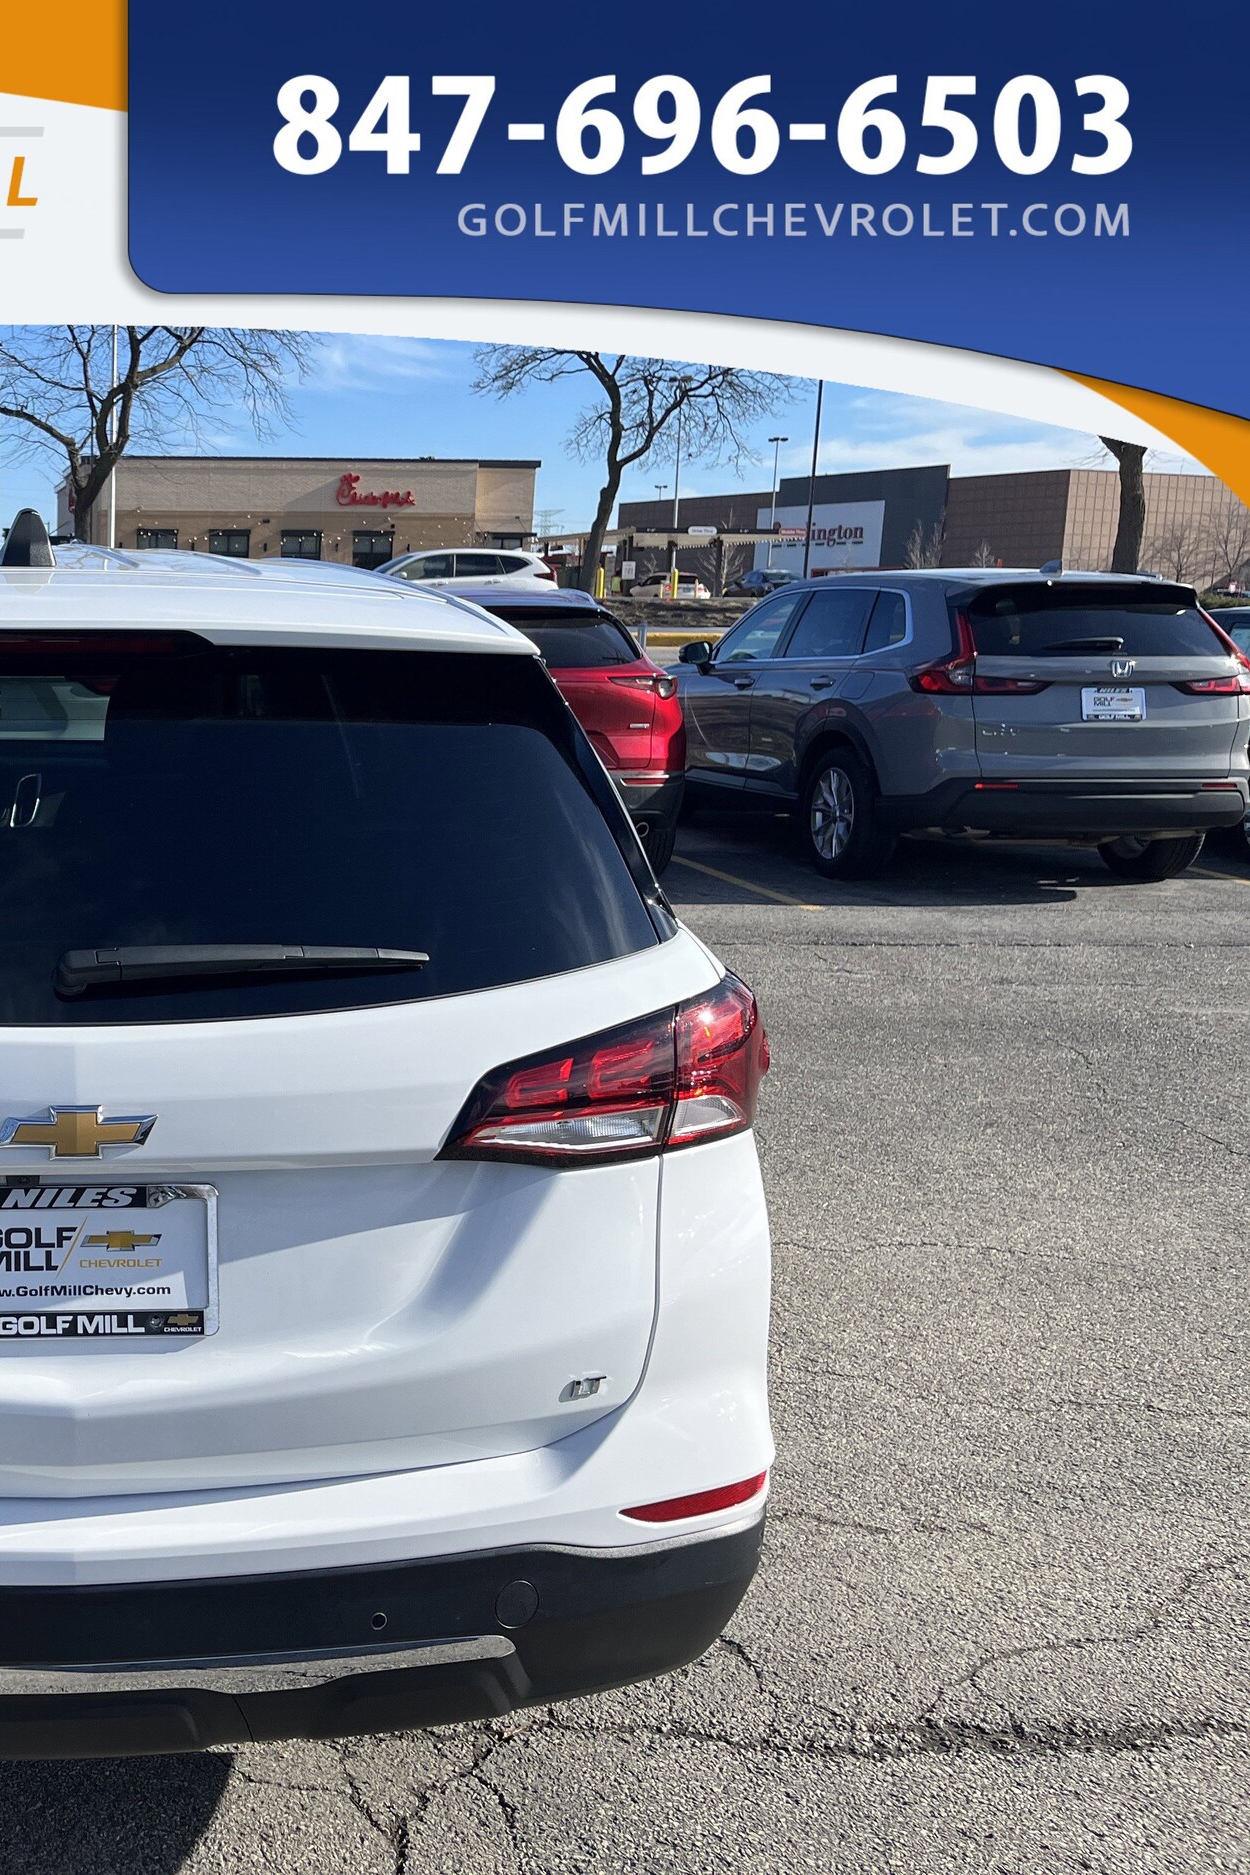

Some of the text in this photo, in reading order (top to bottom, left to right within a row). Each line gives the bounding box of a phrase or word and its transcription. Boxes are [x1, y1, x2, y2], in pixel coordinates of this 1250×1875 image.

[1, 1186, 138, 1209] NILES
[78, 1257, 163, 1269] CHEVROLET
[76, 1314, 146, 1335] MILL
[163, 1325, 202, 1333] CHEVROLET
[571, 1374, 607, 1400] LT
